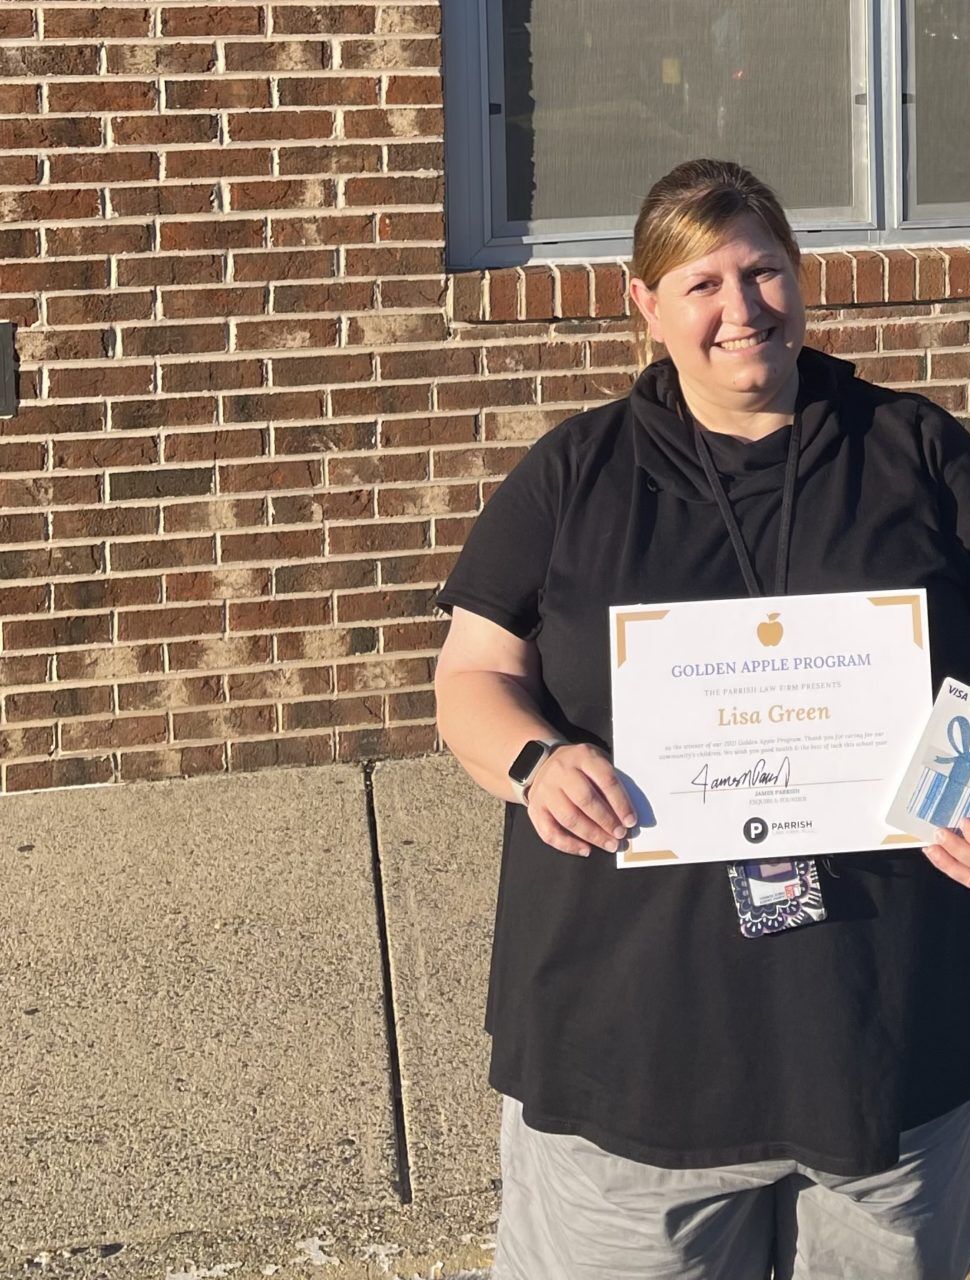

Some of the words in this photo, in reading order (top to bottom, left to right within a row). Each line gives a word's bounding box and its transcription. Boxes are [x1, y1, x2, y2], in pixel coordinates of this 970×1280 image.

[671, 661, 736, 678] GOLDEN
[741, 658, 790, 673] APPLE
[793, 653, 871, 669] PROGRAM
[723, 687, 757, 696] PARRISH
[779, 684, 799, 692] FIRM
[801, 681, 842, 690] PRESENTS
[948, 685, 969, 701] VISA
[717, 706, 762, 726] Lisa
[767, 704, 831, 723] Green
[771, 820, 813, 830] PARRISH
